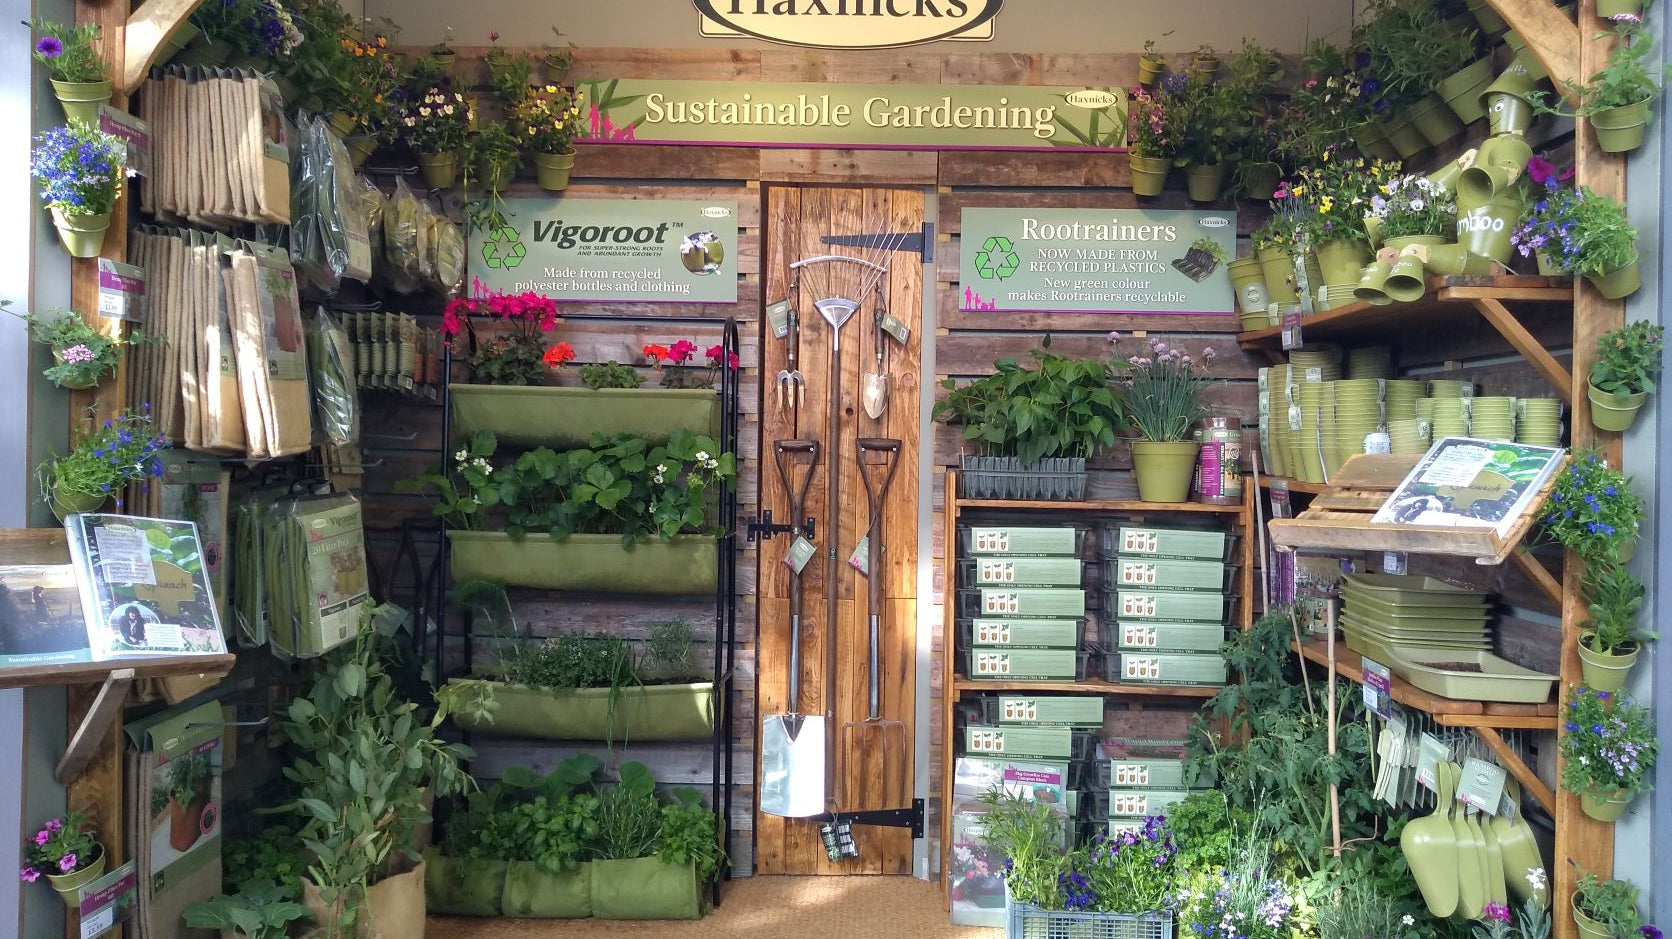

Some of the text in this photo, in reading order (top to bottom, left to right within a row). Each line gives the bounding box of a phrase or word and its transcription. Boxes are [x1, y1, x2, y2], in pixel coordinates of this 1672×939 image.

[1070, 95, 1113, 104] Haxnicks
[645, 93, 1056, 138] Sustainable Gardening
[532, 220, 669, 250] Vigoroot
[1020, 218, 1177, 242] Rootrainers
[1037, 248, 1158, 261] NOW MADE FROM
[1030, 261, 1166, 274] RECYCLED PLASTICS
[543, 267, 662, 283] Made from recycled
[515, 280, 691, 295] polyester bottles and clothing
[1043, 277, 1151, 291] New green colour
[1007, 290, 1186, 304] makes Rootrainers recyclable
